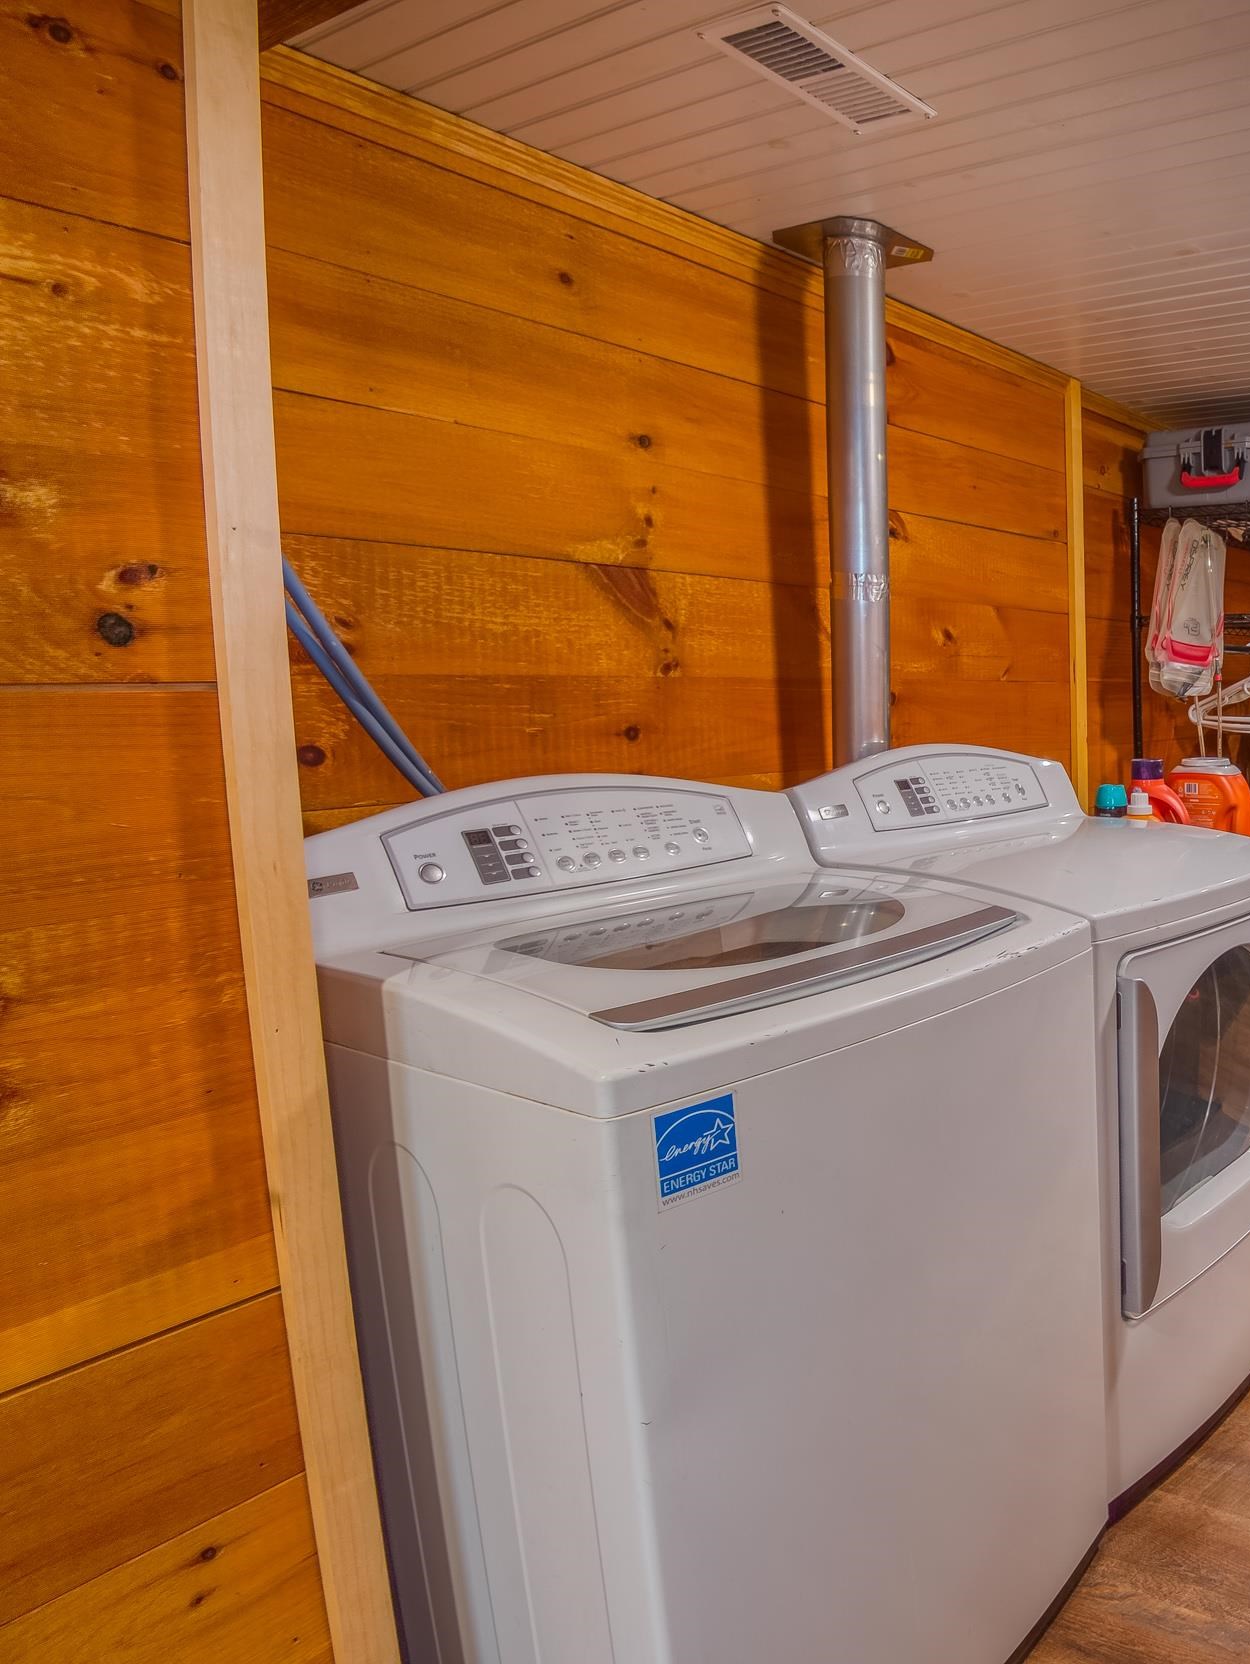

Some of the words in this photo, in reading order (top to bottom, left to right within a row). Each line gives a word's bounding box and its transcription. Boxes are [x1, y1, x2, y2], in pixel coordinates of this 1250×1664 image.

[661, 1172, 740, 1207] www.nhsaves.com
[663, 1168, 707, 1194] ENERGY
[709, 1157, 736, 1177] STAR
